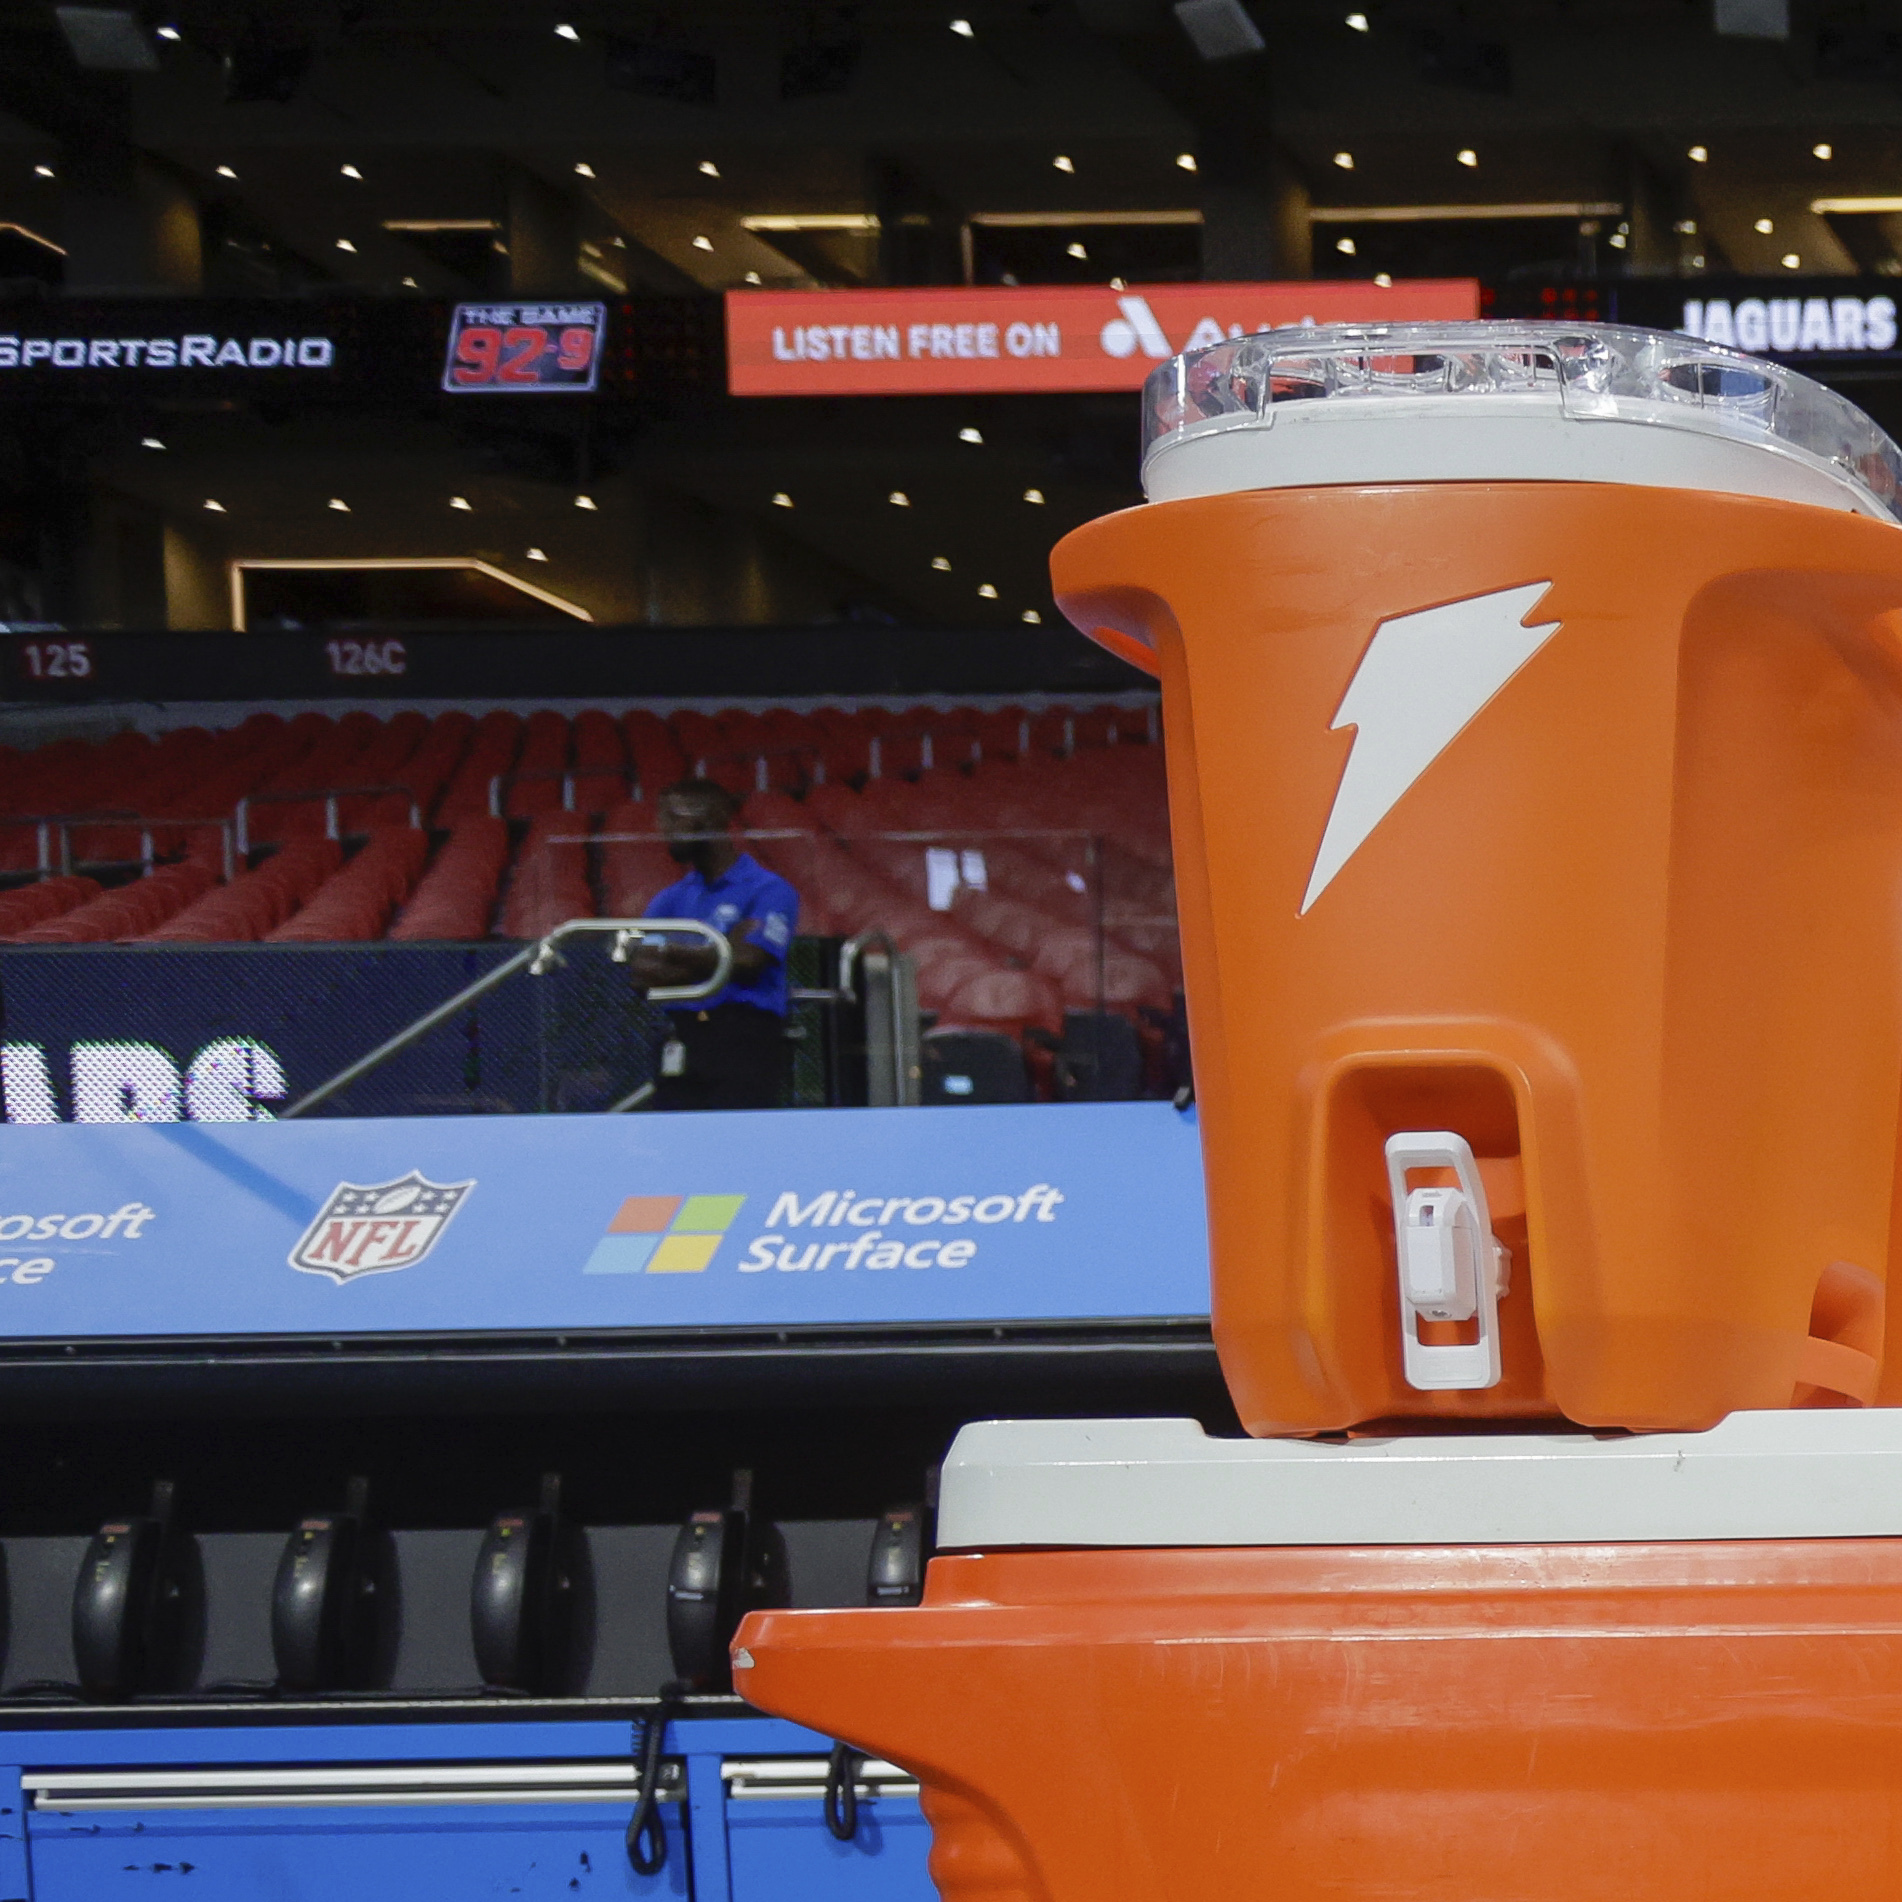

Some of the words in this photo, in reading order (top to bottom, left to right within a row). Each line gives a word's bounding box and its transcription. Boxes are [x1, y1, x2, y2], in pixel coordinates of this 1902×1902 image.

[772, 325, 899, 361] LISTEN
[906, 323, 999, 358] FREE
[1004, 321, 1060, 358] ON
[1684, 297, 1898, 352] JAGUARS
[26, 643, 91, 678] 125
[327, 640, 407, 675] 126C
[765, 1183, 1064, 1228] Microsoft
[308, 1220, 422, 1266] NFL
[738, 1234, 977, 1273] Surface
